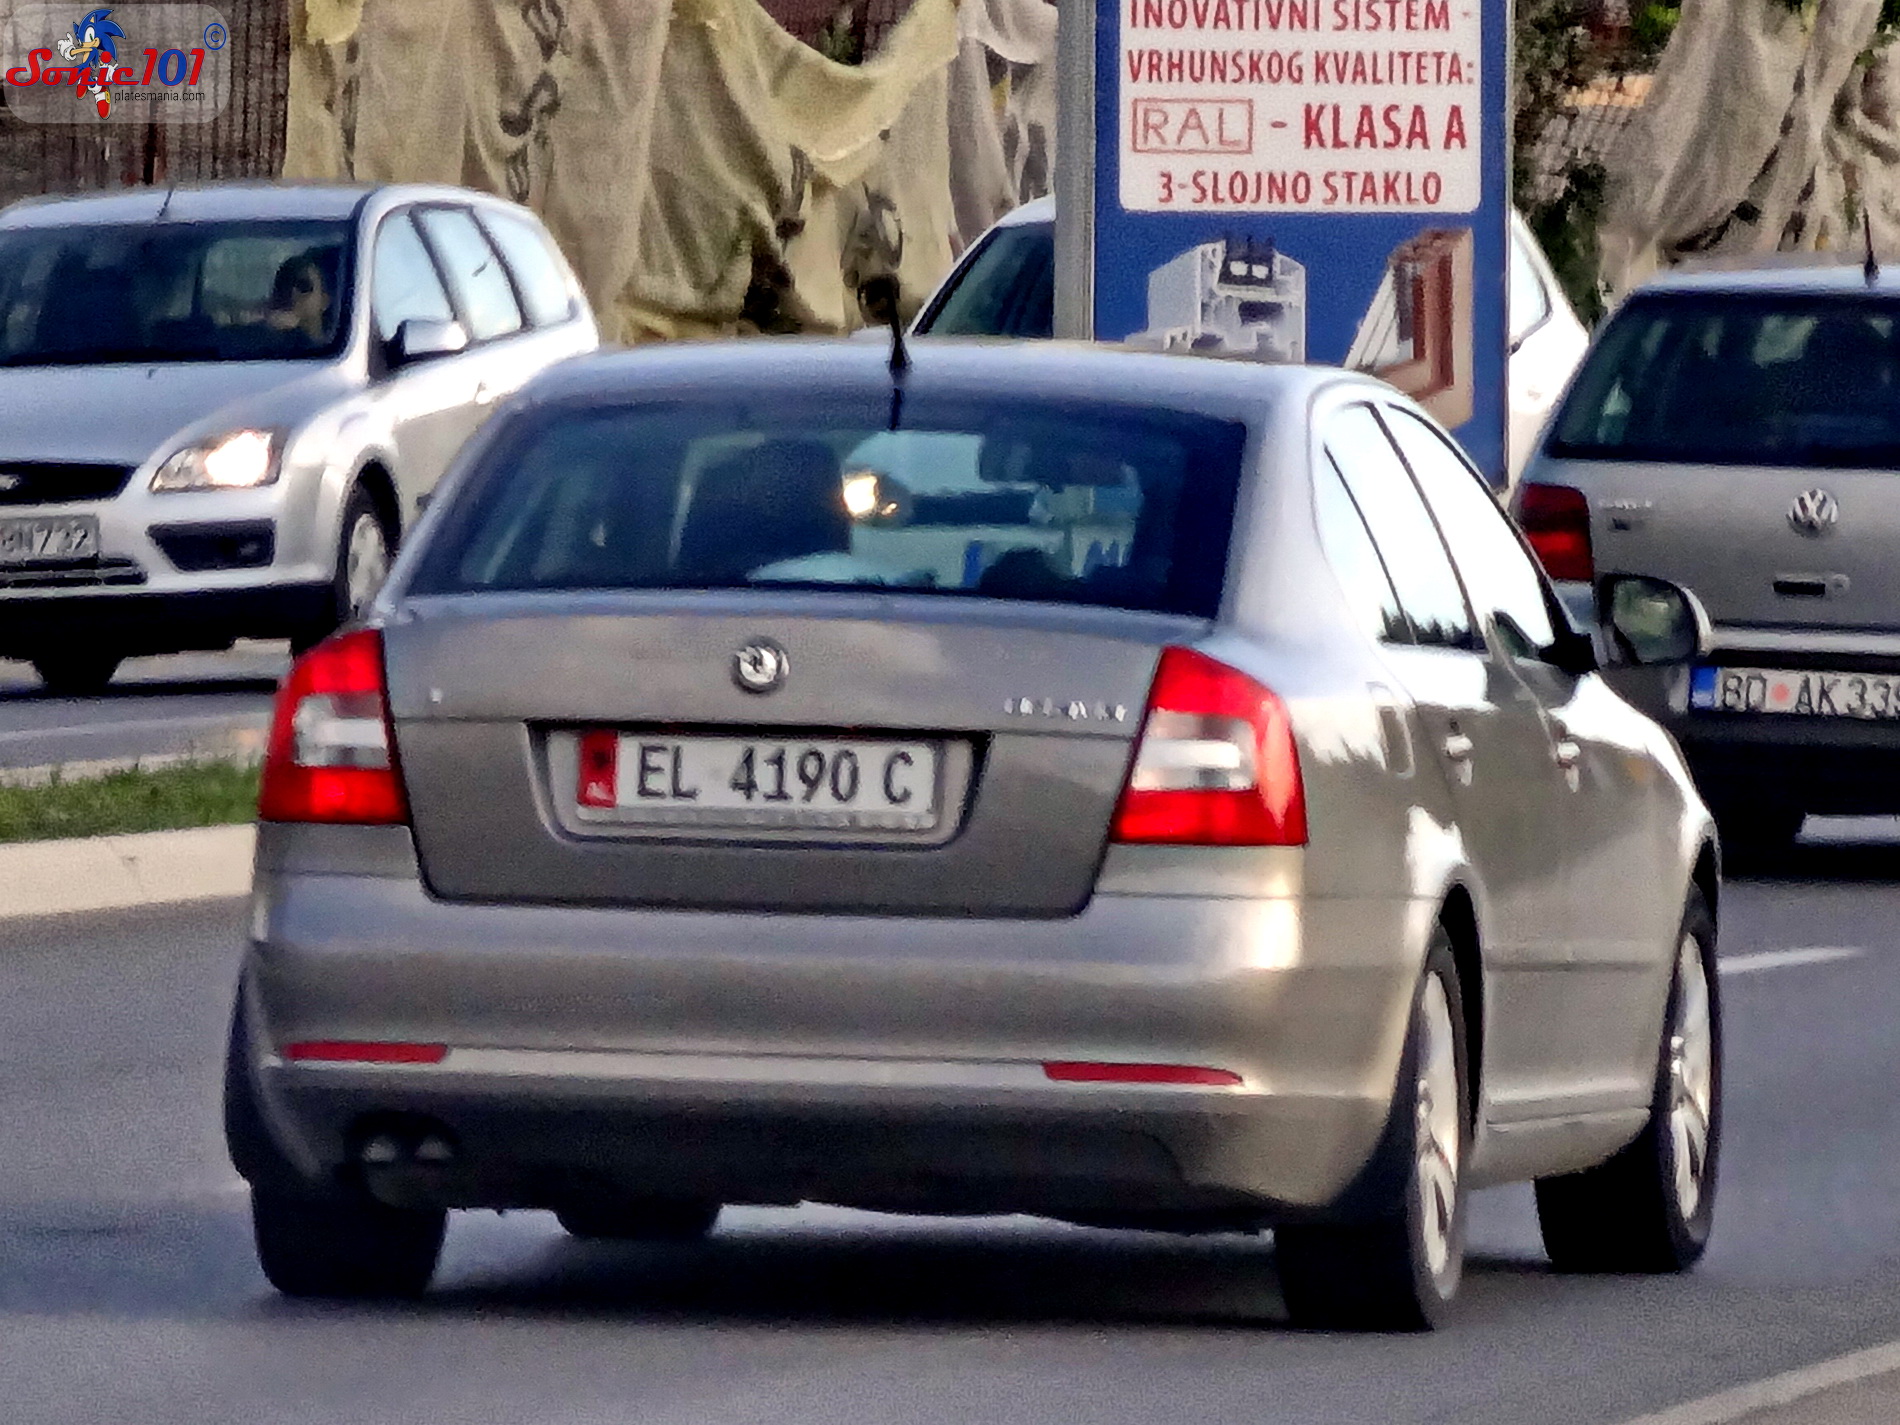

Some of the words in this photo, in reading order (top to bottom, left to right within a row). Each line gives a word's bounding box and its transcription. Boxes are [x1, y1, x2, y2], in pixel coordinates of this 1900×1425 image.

[1131, 0, 1320, 31] INOVATIVNI
[1332, 0, 1450, 31] SISTEM
[1128, 50, 1303, 84] VRHUNSKOG
[1314, 51, 1474, 85] KVALITETA:
[1143, 107, 1242, 146] RAL
[1304, 103, 1430, 149] KLASA
[1443, 104, 1467, 149] A
[1158, 170, 1311, 205] 3-SLOJNO
[1322, 171, 1442, 205] STAKLO
[637, 743, 700, 798] EL
[729, 745, 861, 802] 4190
[884, 750, 914, 804] C
